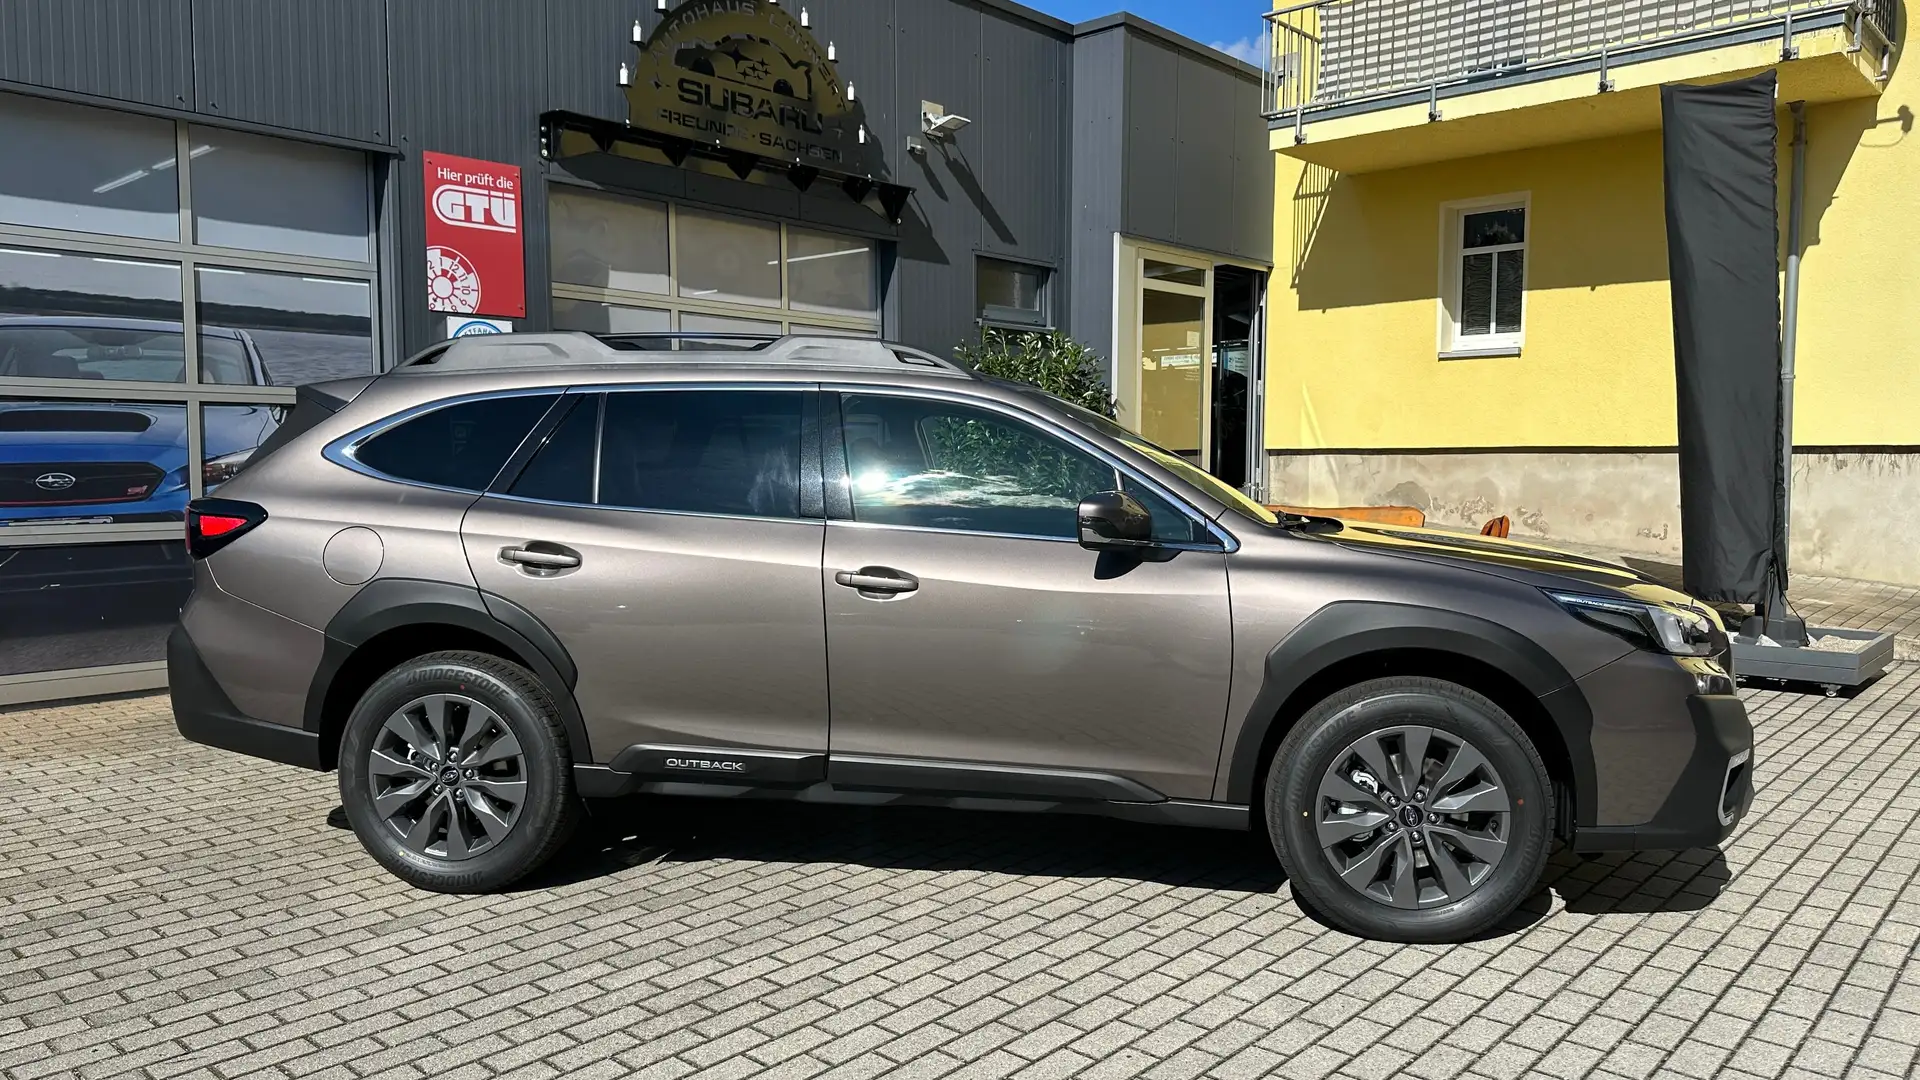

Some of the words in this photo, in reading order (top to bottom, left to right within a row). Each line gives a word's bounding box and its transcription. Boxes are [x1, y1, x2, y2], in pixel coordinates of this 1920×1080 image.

[677, 77, 823, 135] SUBARU
[657, 108, 749, 141] FREUNDE
[759, 132, 843, 164] SACHSEN
[437, 167, 462, 182] Hier
[465, 173, 494, 188] prüft
[496, 176, 514, 190] die
[434, 187, 517, 230] GTÜ
[449, 261, 460, 274] 12
[458, 272, 468, 282] 11
[461, 285, 471, 296] 10
[404, 668, 509, 701] BRIDGESTONE
[666, 758, 743, 771] OUTBACK
